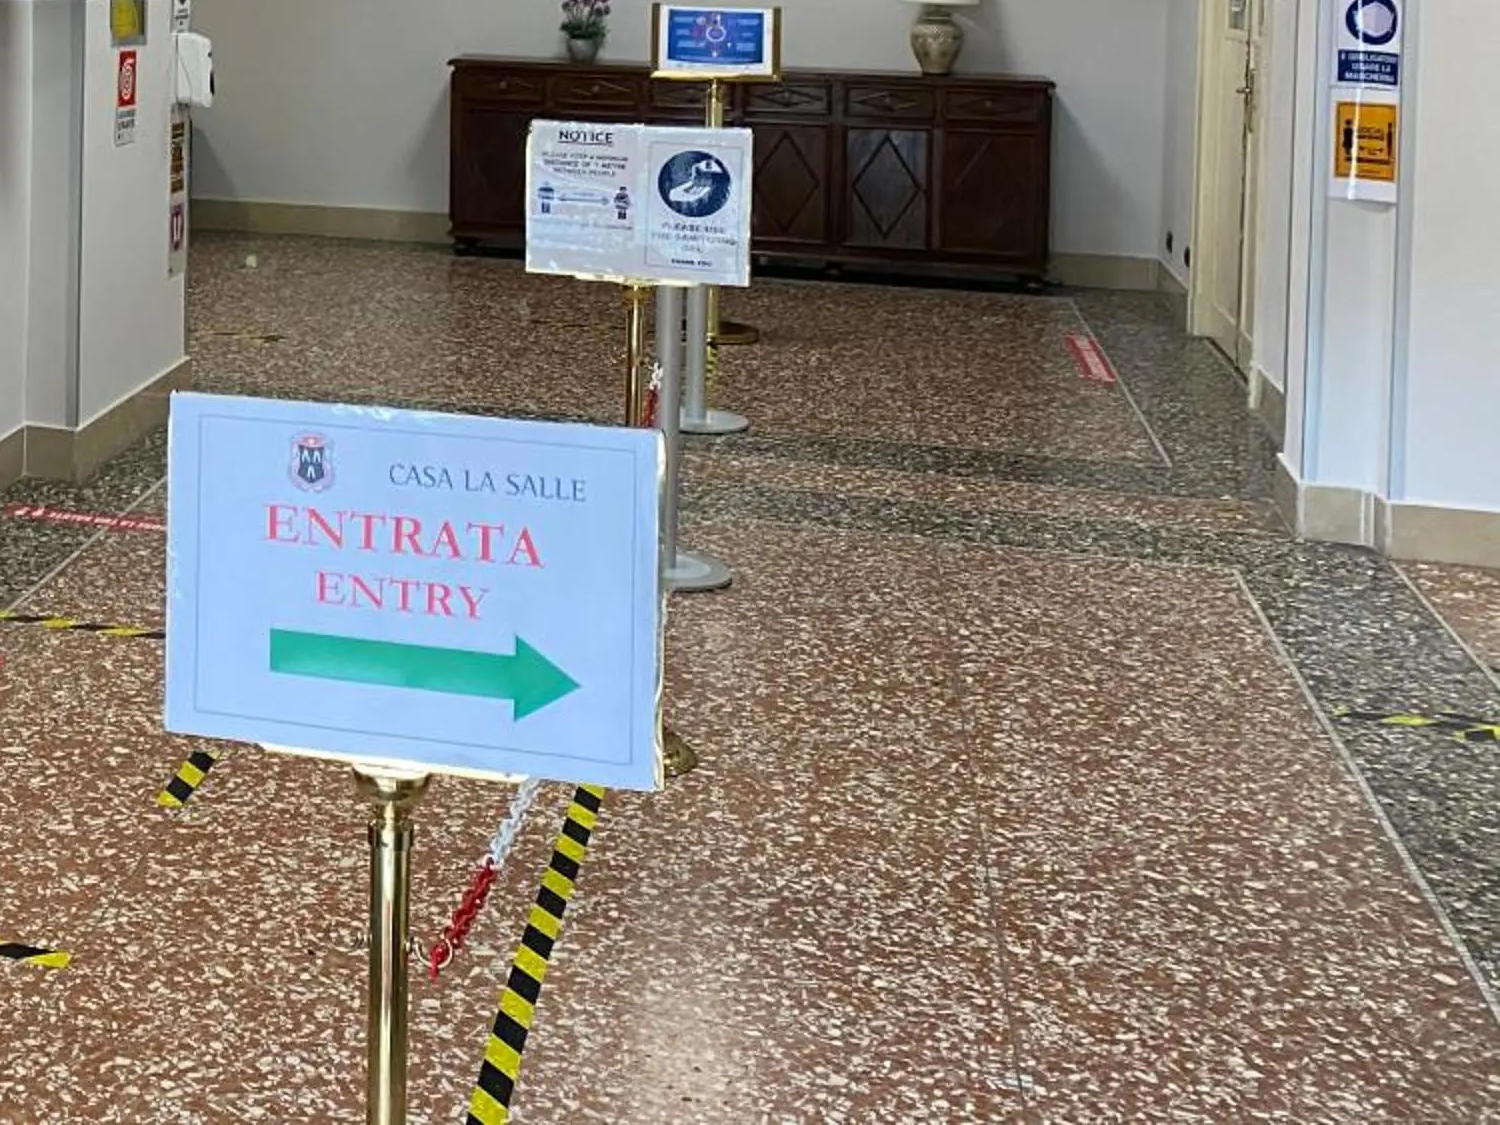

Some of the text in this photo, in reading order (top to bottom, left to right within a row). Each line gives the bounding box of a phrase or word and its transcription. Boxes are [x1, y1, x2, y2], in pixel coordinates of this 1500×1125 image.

[559, 130, 614, 144] NOTICE
[389, 463, 587, 503] CASA LA SALLE
[263, 504, 545, 568] ENTRATA
[314, 570, 490, 620] ENTRY
